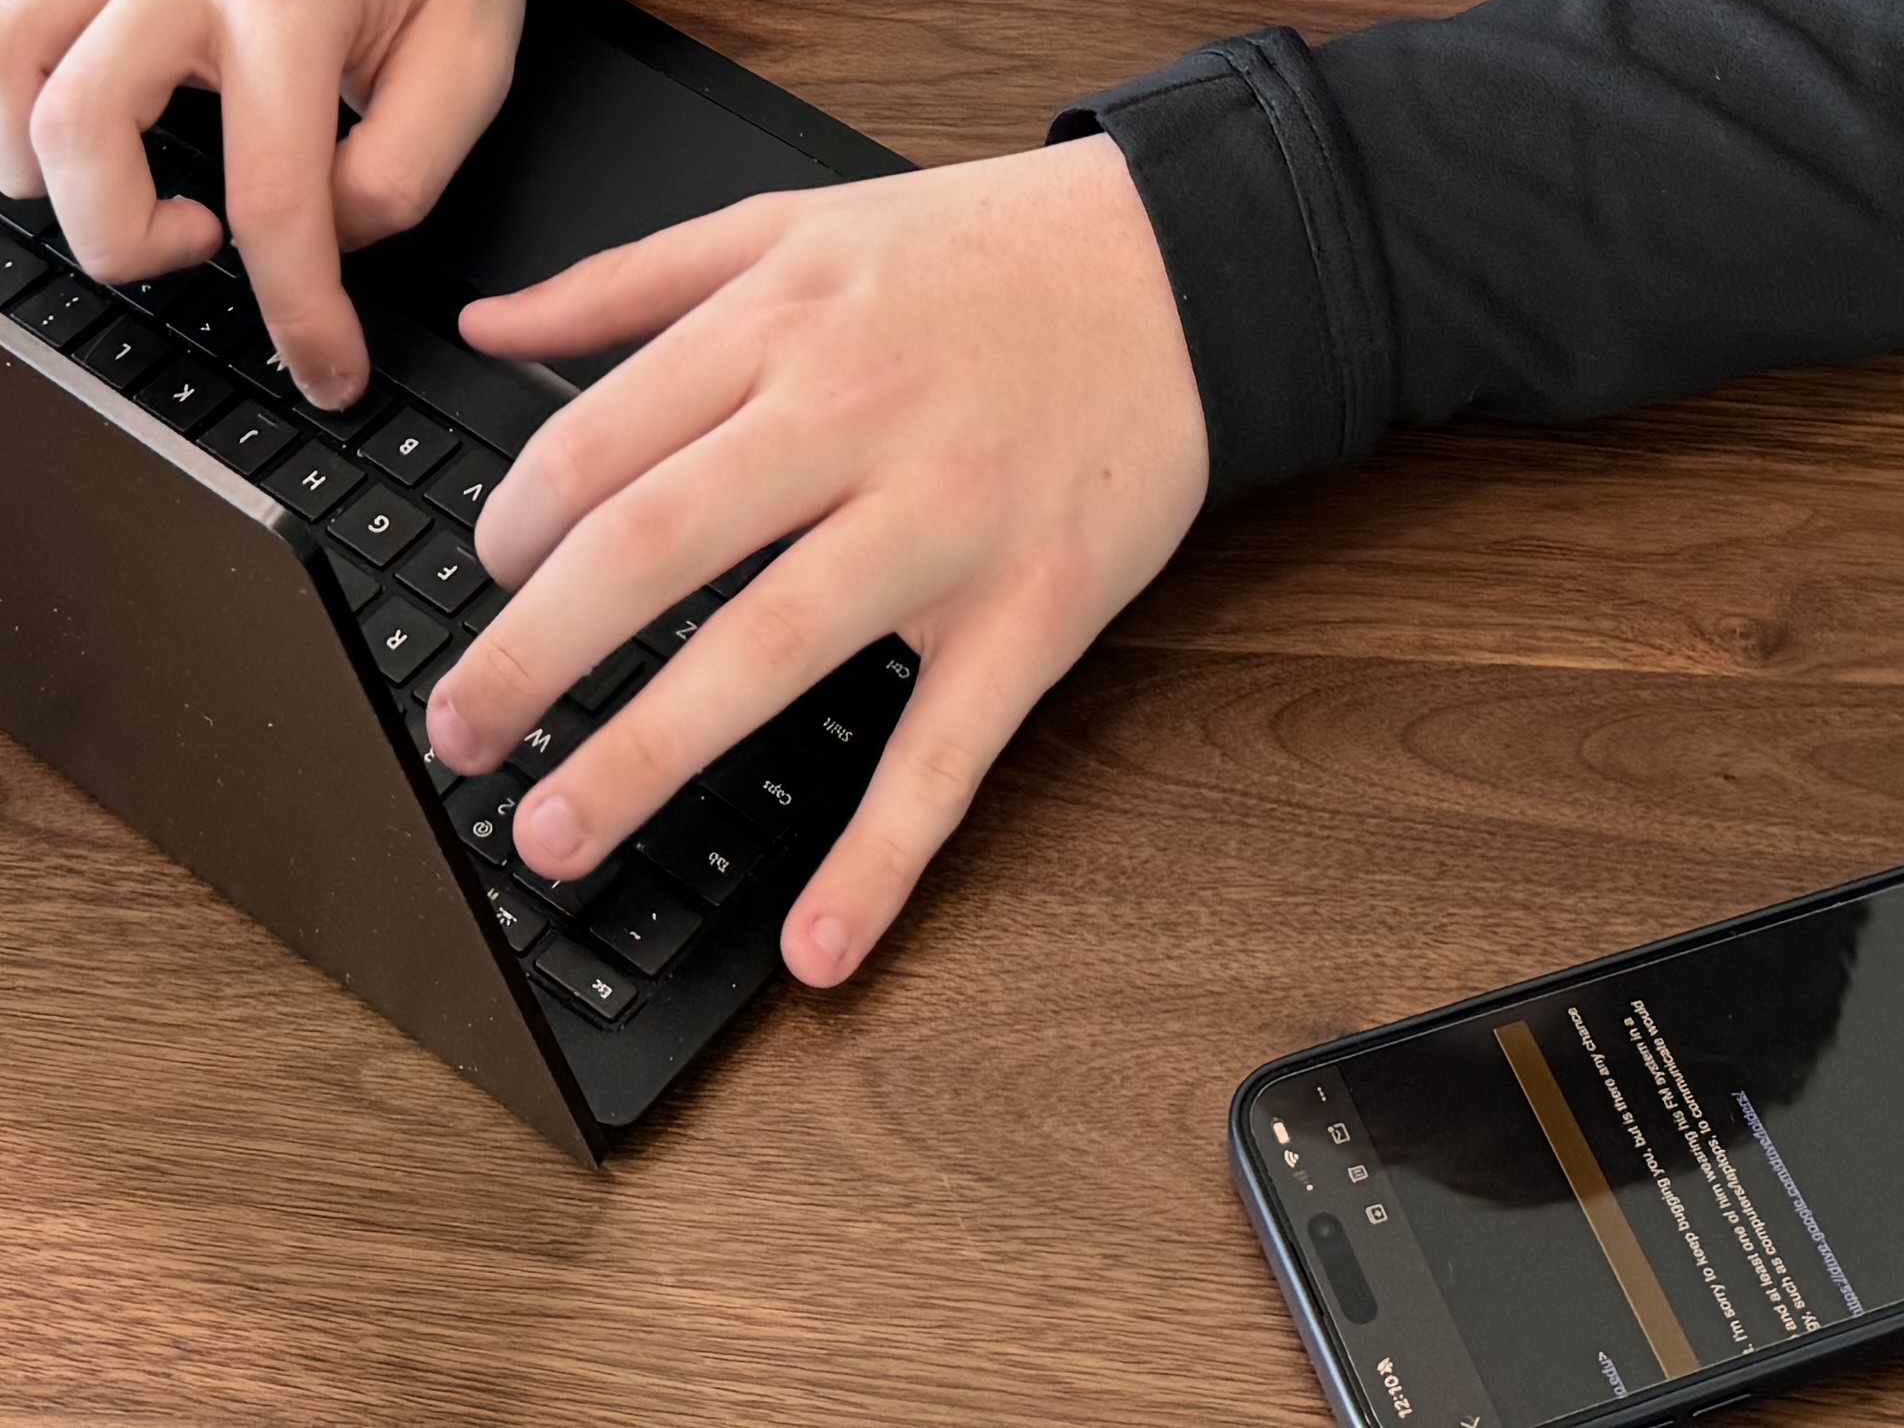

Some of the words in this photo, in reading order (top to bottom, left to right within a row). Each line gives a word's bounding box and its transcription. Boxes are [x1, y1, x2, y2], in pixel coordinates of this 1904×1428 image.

[115, 343, 131, 360] L
[173, 384, 194, 402] K
[239, 429, 258, 444] J
[399, 437, 419, 455] B
[302, 470, 326, 490] H
[463, 483, 482, 501] V
[368, 515, 390, 533] G
[437, 565, 458, 580] F
[386, 629, 407, 650] R
[675, 620, 698, 640] Z
[886, 660, 910, 679] Ctrl
[524, 728, 552, 752] W
[823, 717, 853, 742] Shift
[763, 781, 792, 805] Caps
[472, 820, 493, 837] @
[1624, 1017, 1634, 1026] a
[1631, 1000, 1658, 1036] would
[1568, 1008, 1596, 1051] chance
[1630, 1028, 1641, 1040] in
[1591, 1054, 1609, 1075] any
[1637, 1042, 1666, 1085] system
[1654, 1038, 1702, 1118] communicate
[1605, 1078, 1627, 1111] there
[1658, 1088, 1678, 1109] FM
[1622, 1112, 1634, 1124] is
[1673, 1110, 1689, 1130] his
[1628, 1126, 1646, 1147] but
[1643, 1148, 1664, 1177] you,
[1685, 1131, 1716, 1182] wearing
[1657, 1178, 1689, 1231] bugging
[1712, 1184, 1731, 1208] him
[1723, 1211, 1739, 1223] of
[1734, 1226, 1754, 1251] one
[1685, 1233, 1708, 1266] keep
[1703, 1268, 1716, 1282] to
[1748, 1253, 1772, 1286] least
[1772, 1258, 1786, 1273] as
[1710, 1285, 1735, 1318] sorry
[1766, 1288, 1781, 1301] at
[1782, 1277, 1804, 1308] such
[1774, 1304, 1796, 1330] and
[1730, 1320, 1747, 1342] I'm
[1384, 1374, 1413, 1419] 12:10
